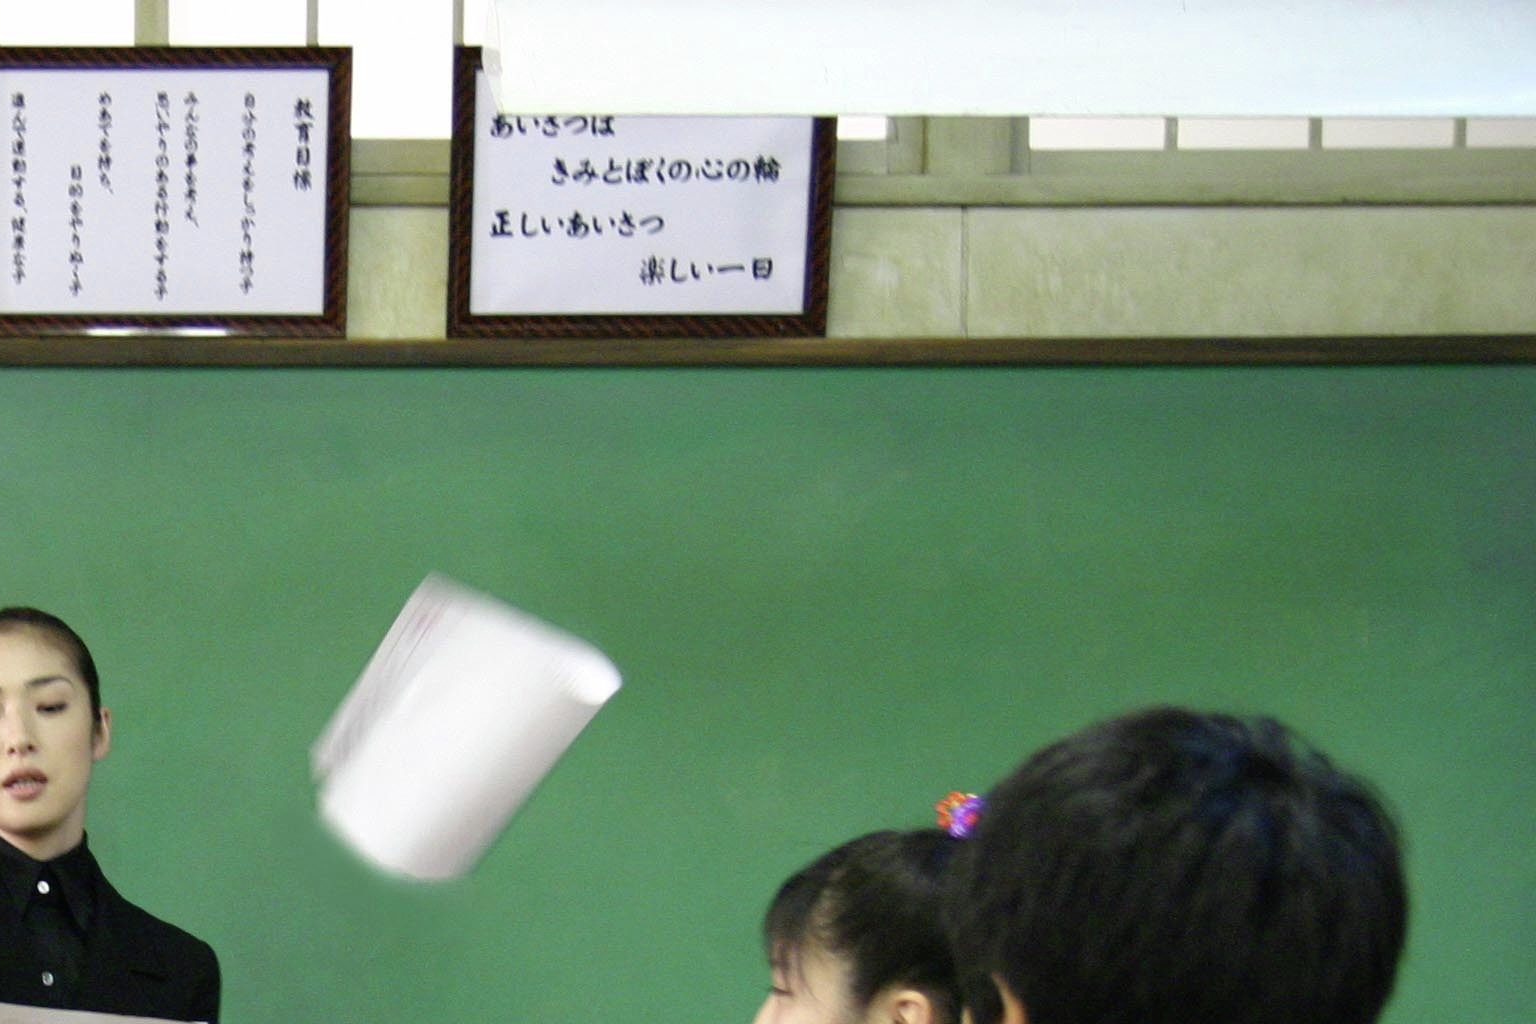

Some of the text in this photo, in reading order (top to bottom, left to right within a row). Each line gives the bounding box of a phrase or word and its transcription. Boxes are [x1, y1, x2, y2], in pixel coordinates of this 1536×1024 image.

[490, 115, 615, 139] あいさつは
[293, 98, 314, 190] 教育目標
[552, 155, 781, 185] きみとぼくの心の輪
[490, 209, 664, 239] 正しいあいさつ
[639, 255, 773, 286] 楽しい一日
